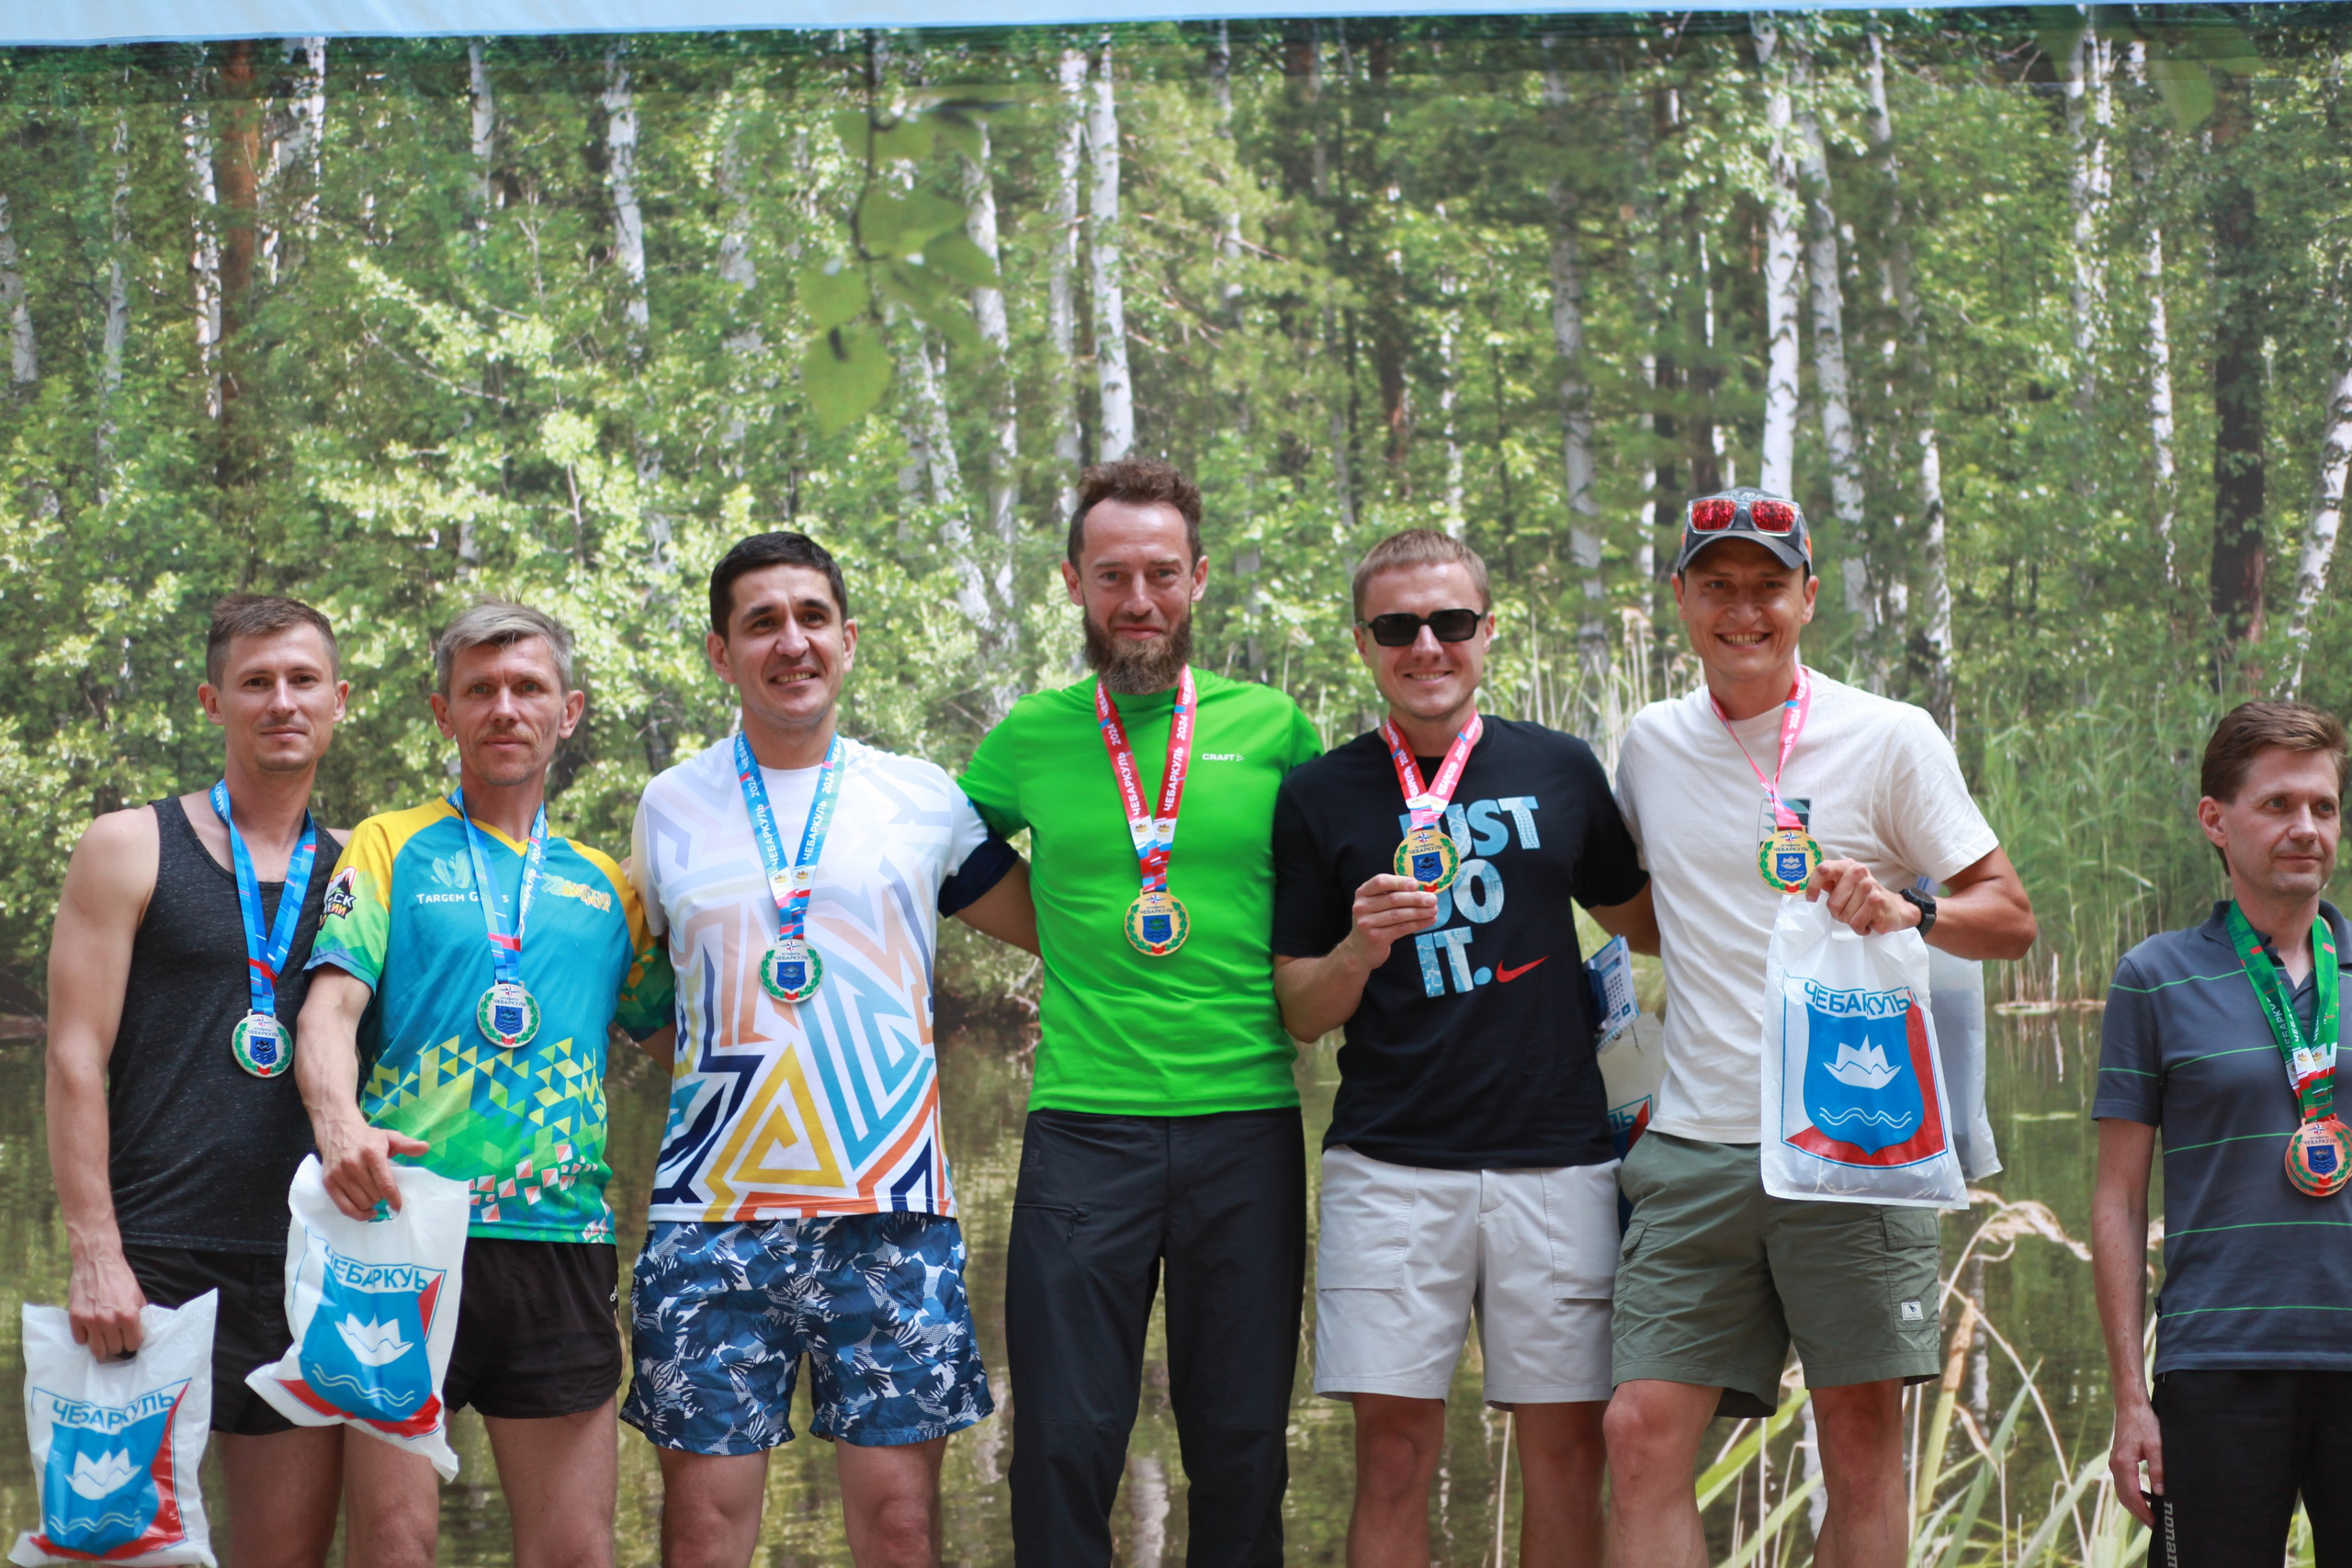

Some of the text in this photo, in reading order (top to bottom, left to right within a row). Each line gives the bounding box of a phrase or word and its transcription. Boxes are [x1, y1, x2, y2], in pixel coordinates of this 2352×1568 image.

[1107, 723, 1141, 817] ЧЕБАРКУЛЬ 2024
[1163, 715, 1188, 812] ЧЕБАРКУЛЬ 2024
[1202, 753, 1235, 761] CRAFT
[748, 775, 779, 866] ЧЕБАРКУЛЬ 2024
[802, 772, 835, 861] ЧЕБАРКУЛЬ 2024
[1415, 926, 1493, 998] IT.
